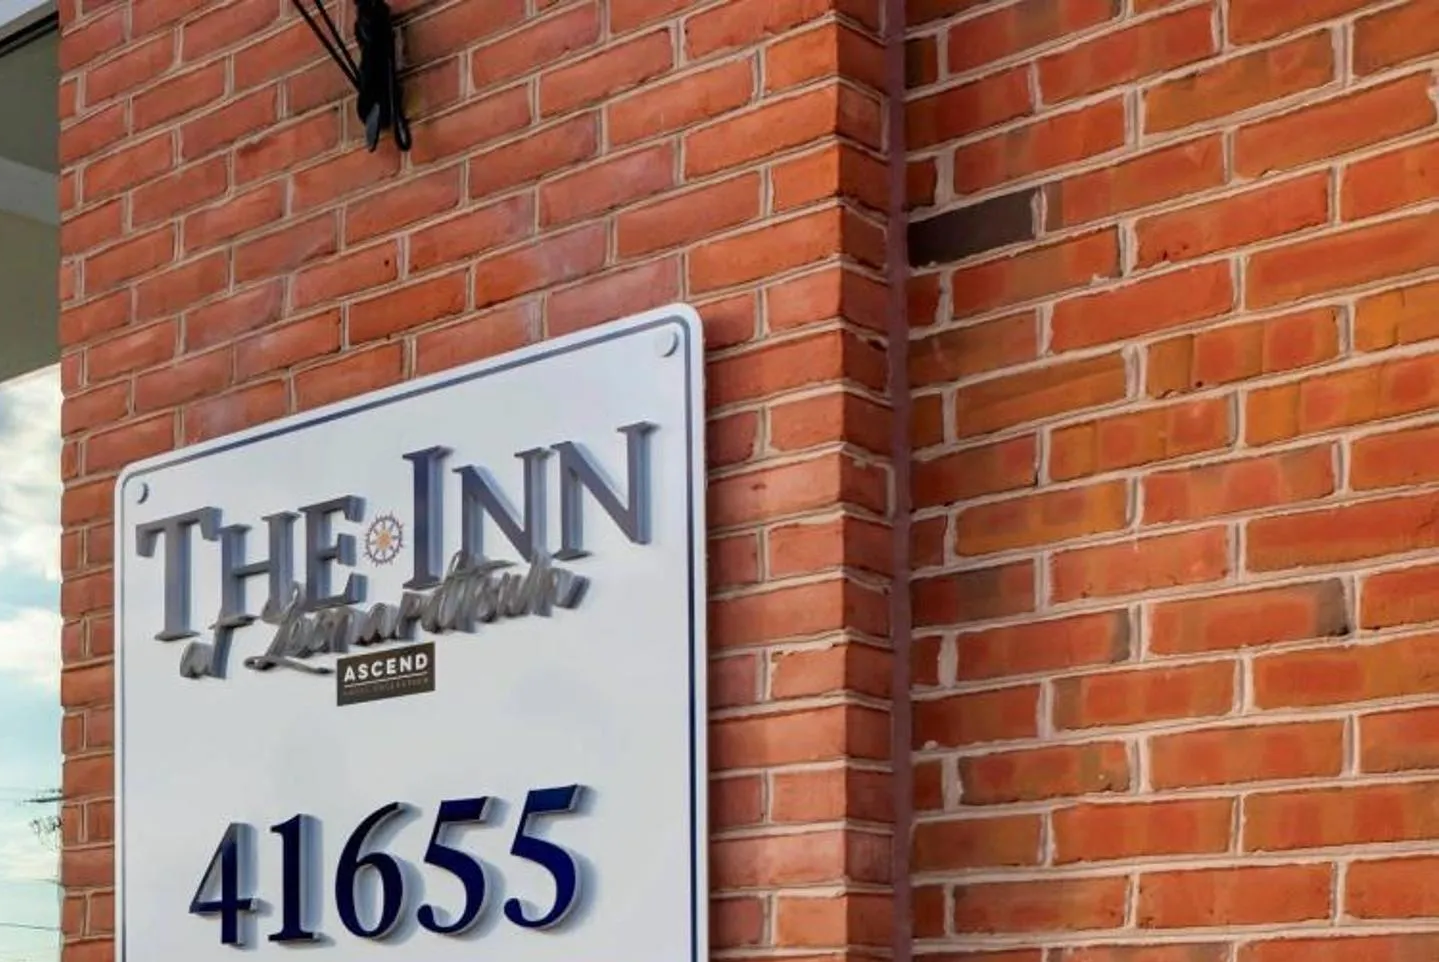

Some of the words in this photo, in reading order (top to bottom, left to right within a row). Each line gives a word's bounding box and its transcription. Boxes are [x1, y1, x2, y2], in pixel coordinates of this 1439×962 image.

[135, 494, 367, 642] THE
[402, 421, 658, 591] INN
[344, 653, 428, 682] ASCEND
[188, 784, 588, 947] 41655
